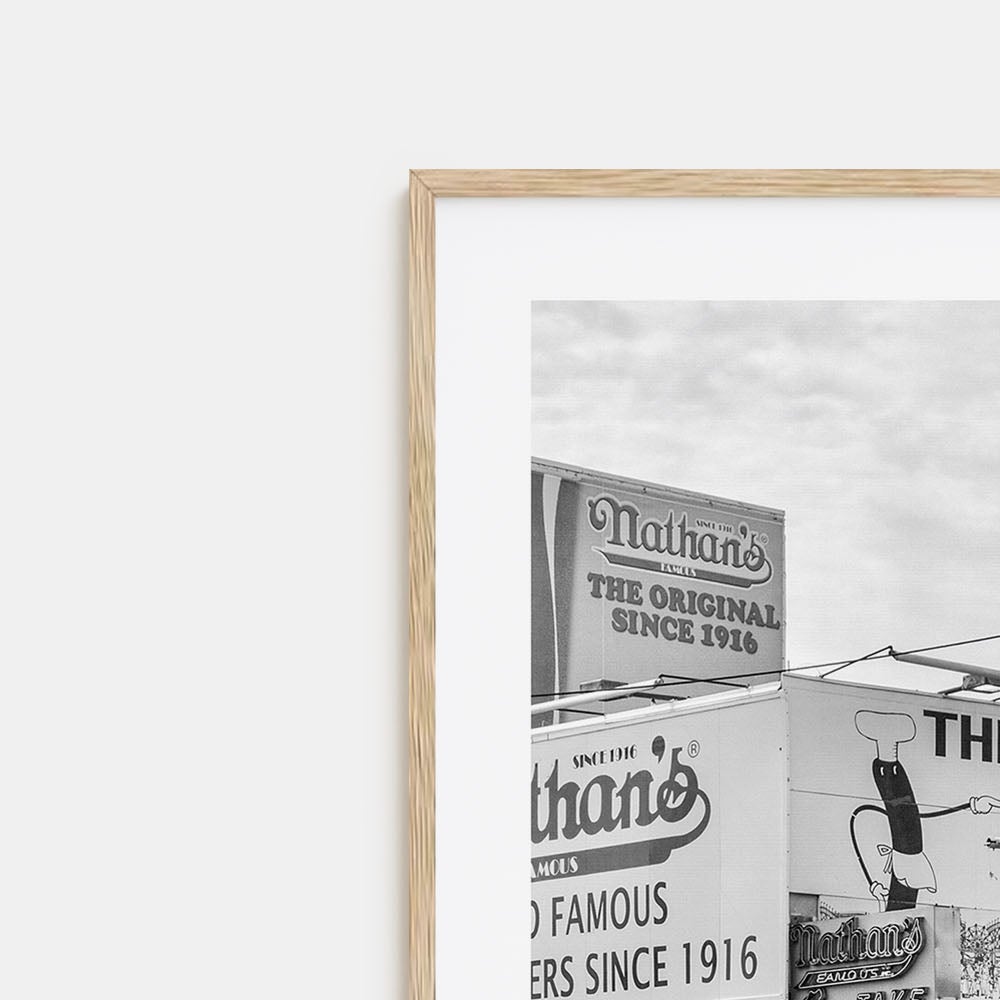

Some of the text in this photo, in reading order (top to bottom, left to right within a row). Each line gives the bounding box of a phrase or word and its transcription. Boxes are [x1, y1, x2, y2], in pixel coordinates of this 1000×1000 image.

[587, 572, 781, 630] THE ORIGINAL
[611, 607, 759, 655] SINCE 1916
[572, 744, 638, 770] SINCE 1916
[552, 881, 668, 937] FAMOUS
[586, 945, 668, 995] SINCE
[682, 935, 758, 984] 1916
